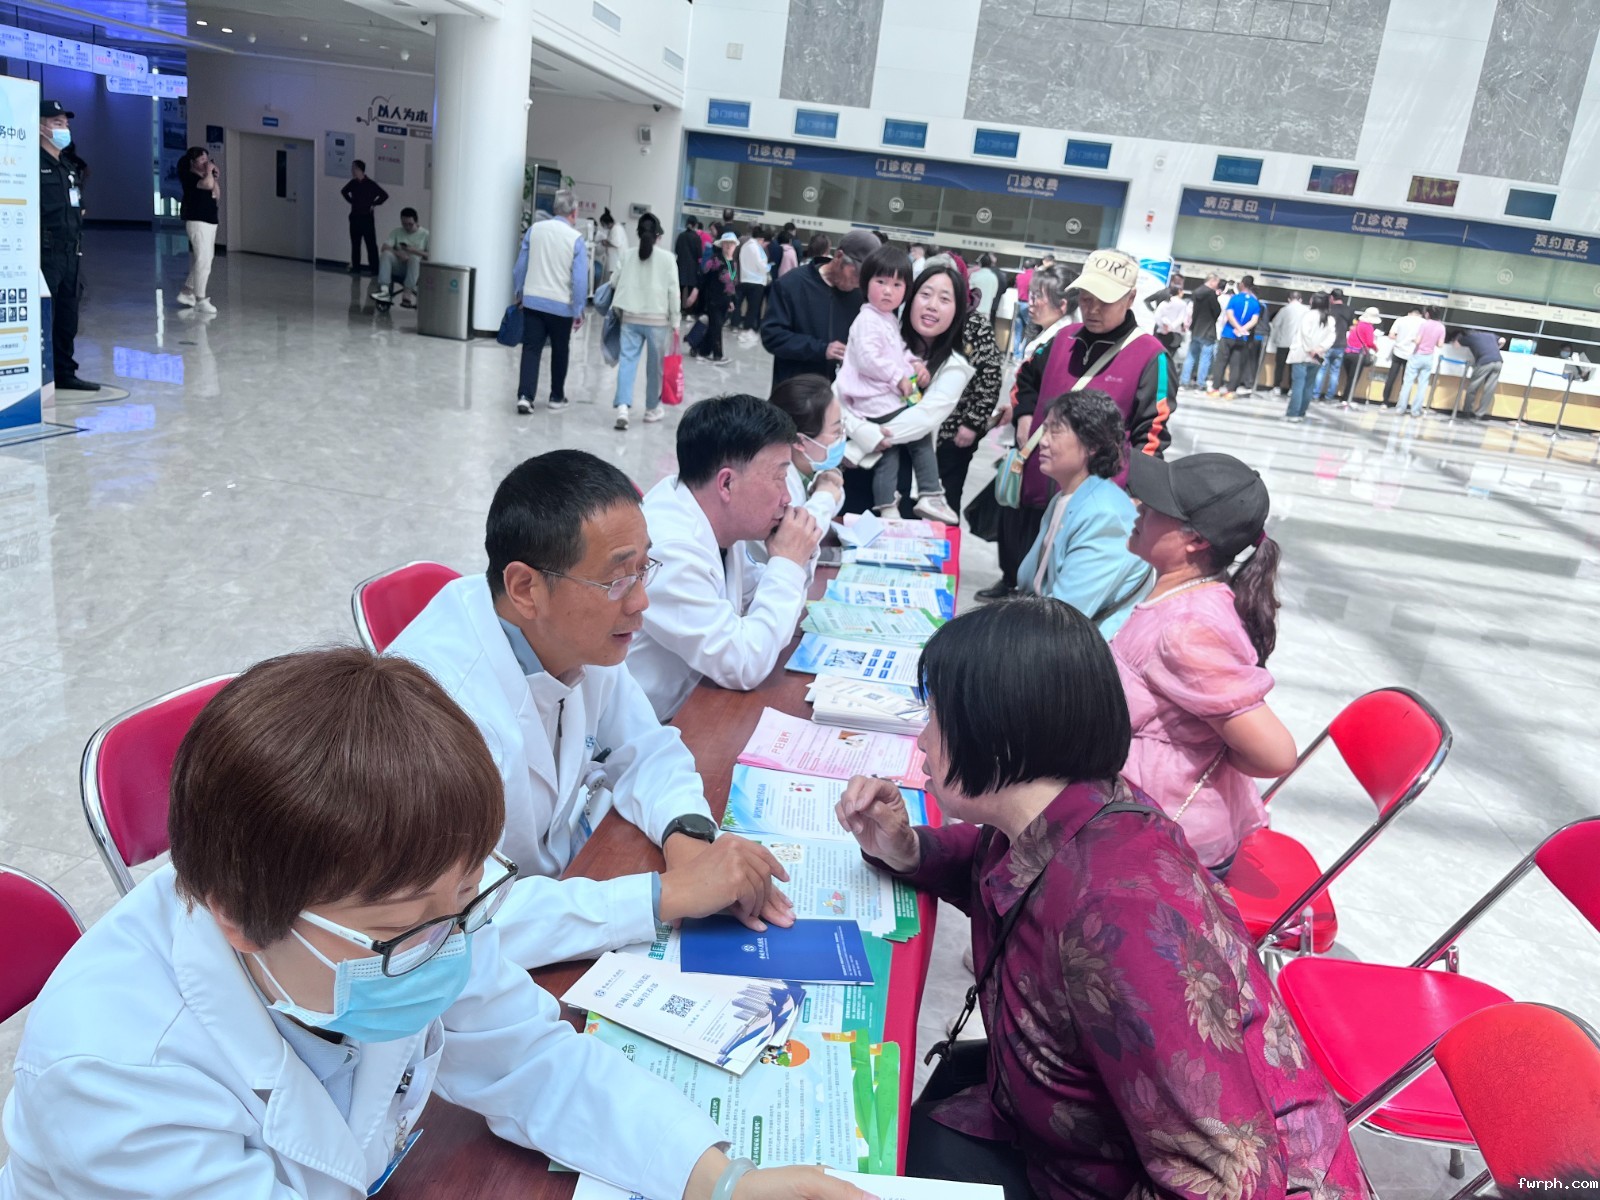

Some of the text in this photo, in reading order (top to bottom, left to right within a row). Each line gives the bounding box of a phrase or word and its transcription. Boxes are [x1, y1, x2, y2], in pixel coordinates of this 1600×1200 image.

[377, 104, 428, 123] 以人为本
[747, 143, 796, 160] 门诊收费
[875, 159, 925, 176] 门诊收费
[1007, 173, 1058, 191] 门诊收费
[1204, 196, 1259, 213] 病历复印
[1352, 211, 1408, 230] 门诊收费
[1535, 233, 1588, 253] 预约服务
[1095, 257, 1132, 279] ORT
